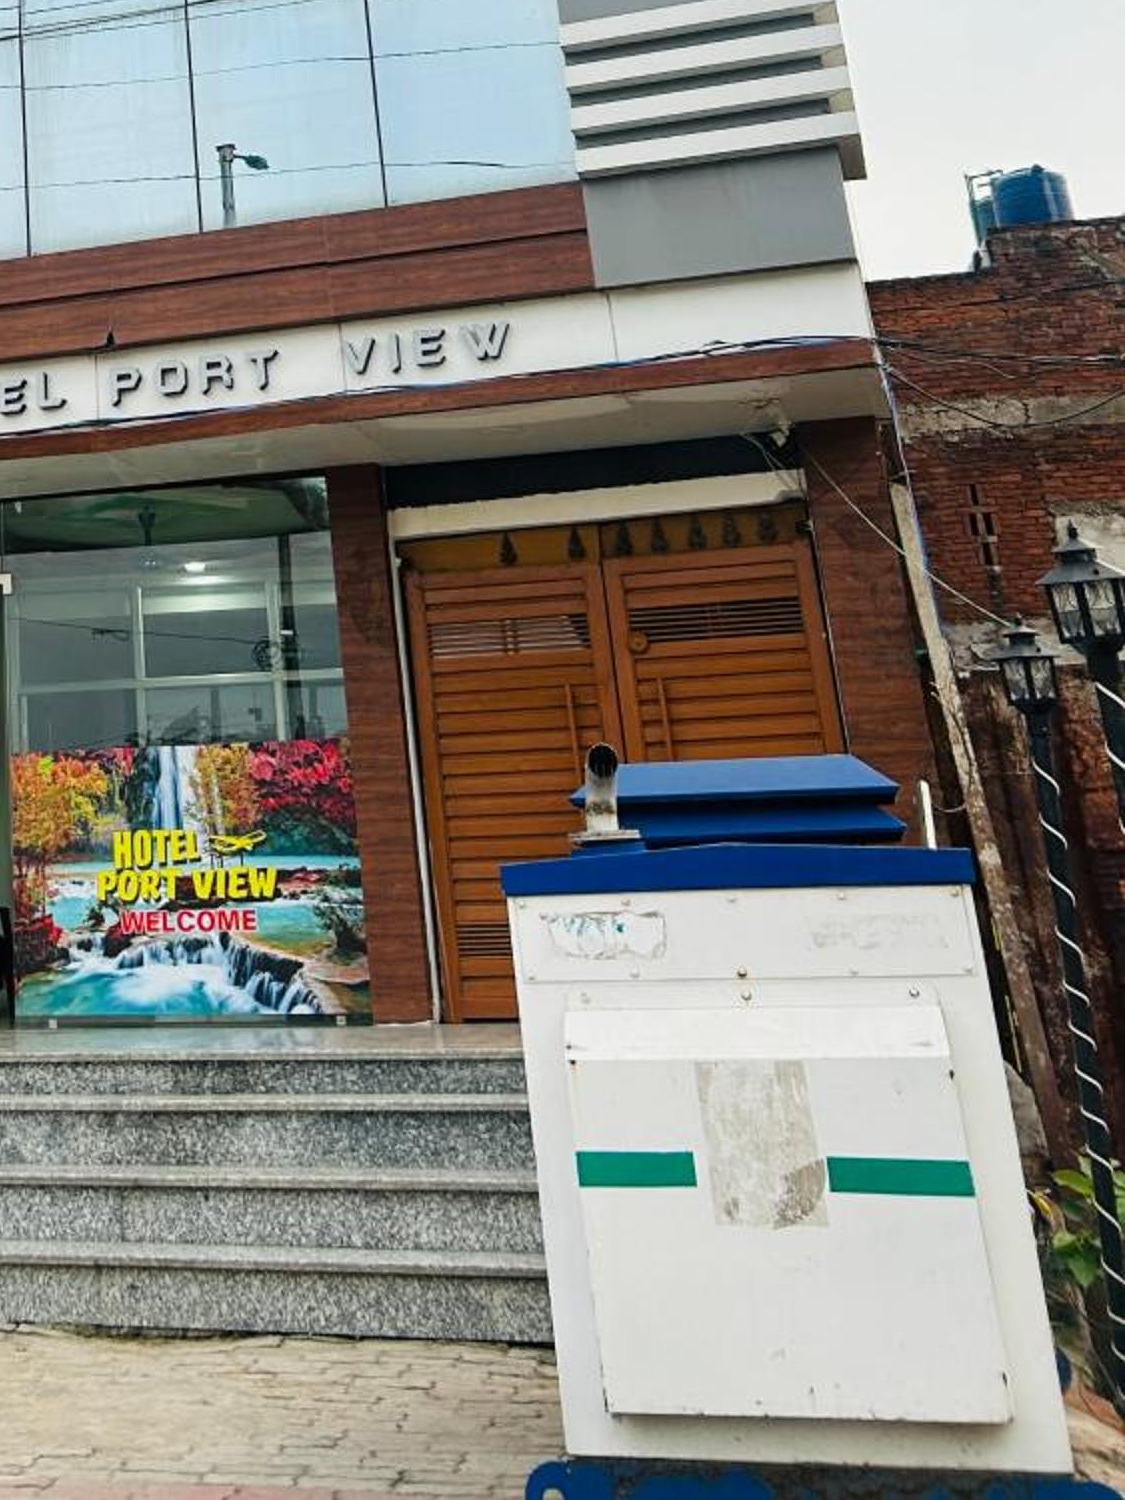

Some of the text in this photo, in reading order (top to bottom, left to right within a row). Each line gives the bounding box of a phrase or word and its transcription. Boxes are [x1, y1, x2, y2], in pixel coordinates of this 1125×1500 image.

[109, 349, 279, 407] PORT
[346, 322, 510, 375] VIEW
[112, 829, 202, 870] HOTEL
[96, 867, 278, 902] PORT VIEW
[121, 909, 258, 933] WELCOME
